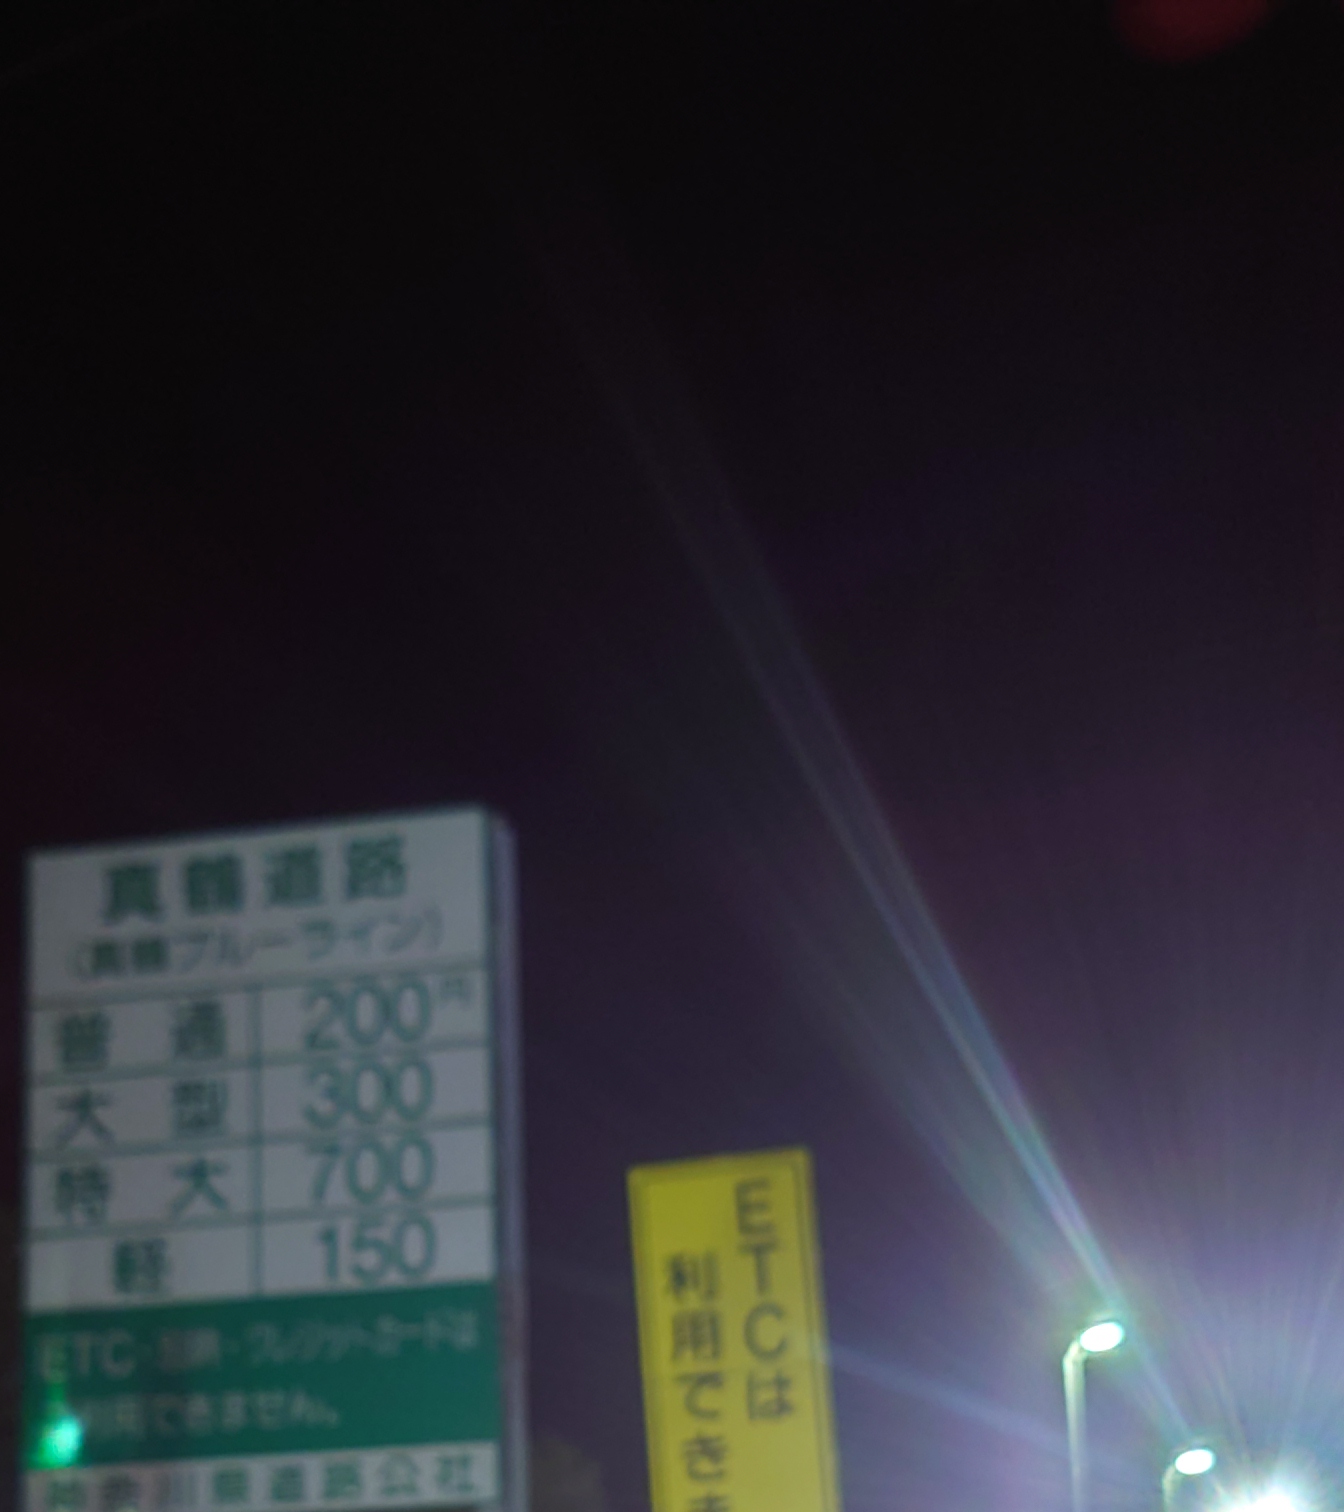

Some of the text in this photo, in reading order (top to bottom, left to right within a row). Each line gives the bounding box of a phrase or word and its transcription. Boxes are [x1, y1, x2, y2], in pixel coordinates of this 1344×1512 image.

[303, 1057, 435, 1128] 300
[308, 1132, 436, 1206] 700
[318, 1211, 437, 1285] 150
[733, 1175, 796, 1422] ETCは
